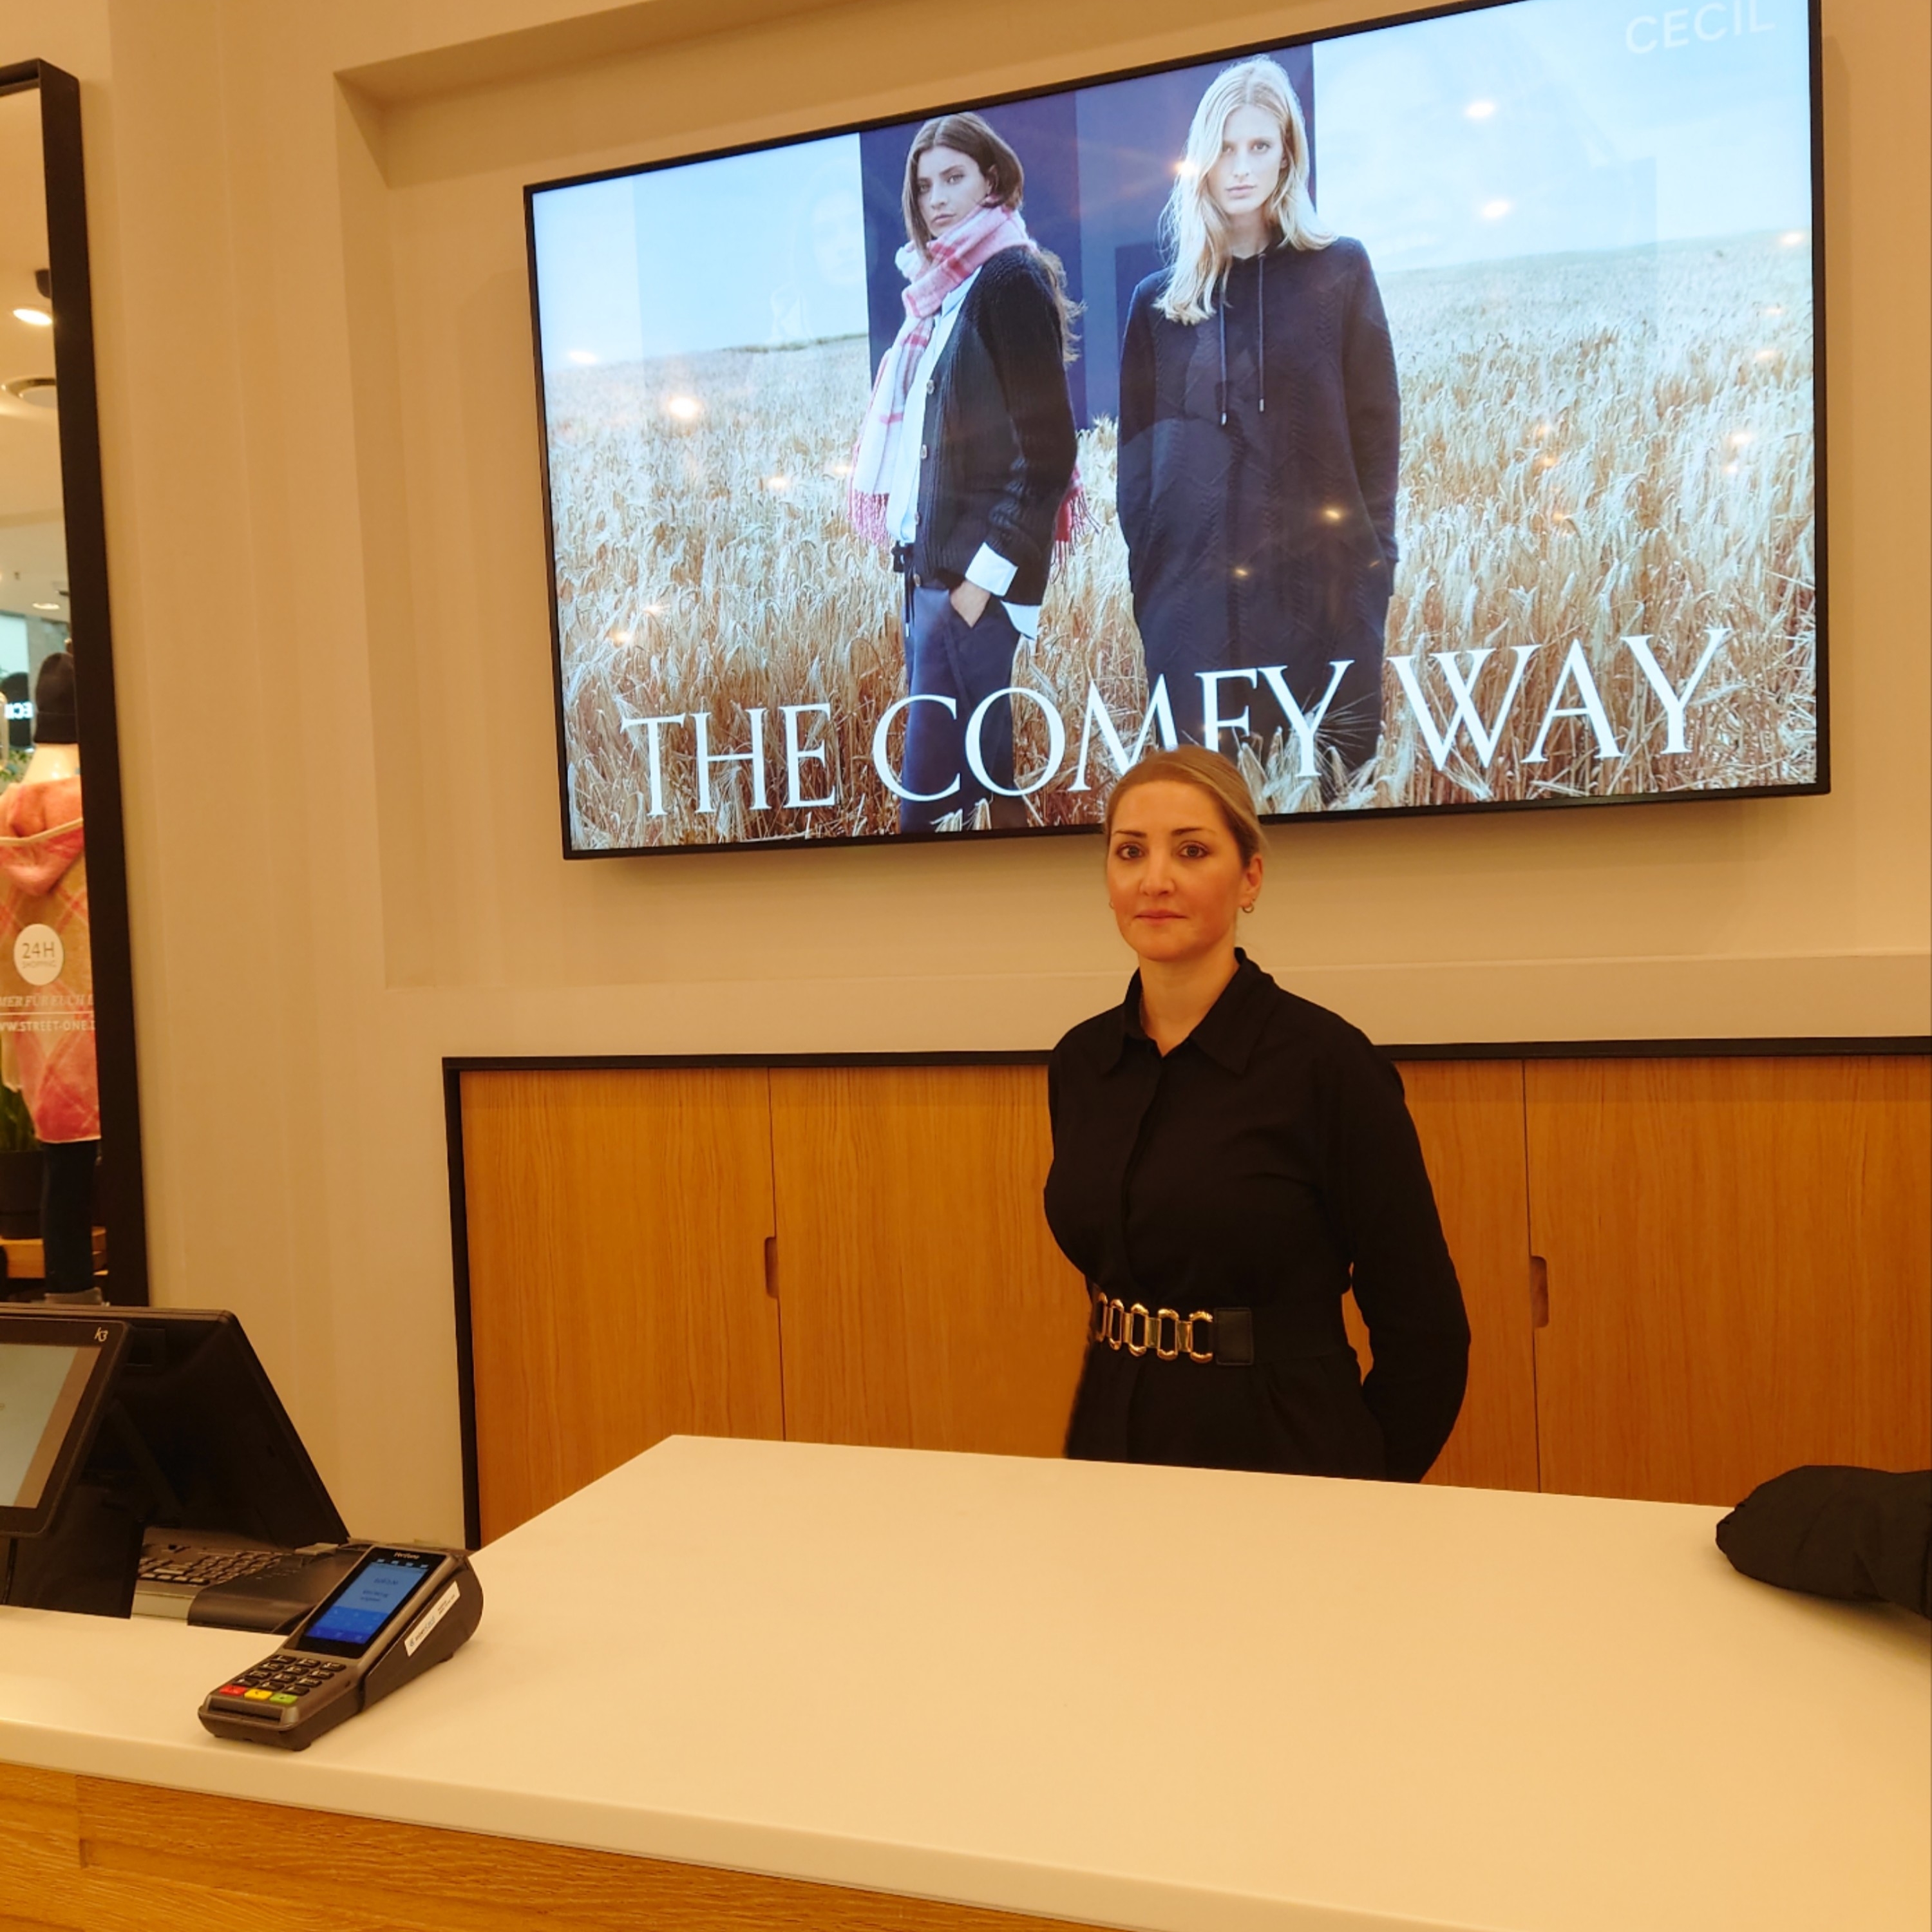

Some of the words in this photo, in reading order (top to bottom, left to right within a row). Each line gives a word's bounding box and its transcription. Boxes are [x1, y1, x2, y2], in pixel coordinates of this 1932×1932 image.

[1625, 0, 1776, 54] CECIL
[620, 702, 837, 817] THE
[872, 658, 1355, 802] COMFY
[1386, 627, 1732, 772] WAY
[22, 942, 55, 959] 24H
